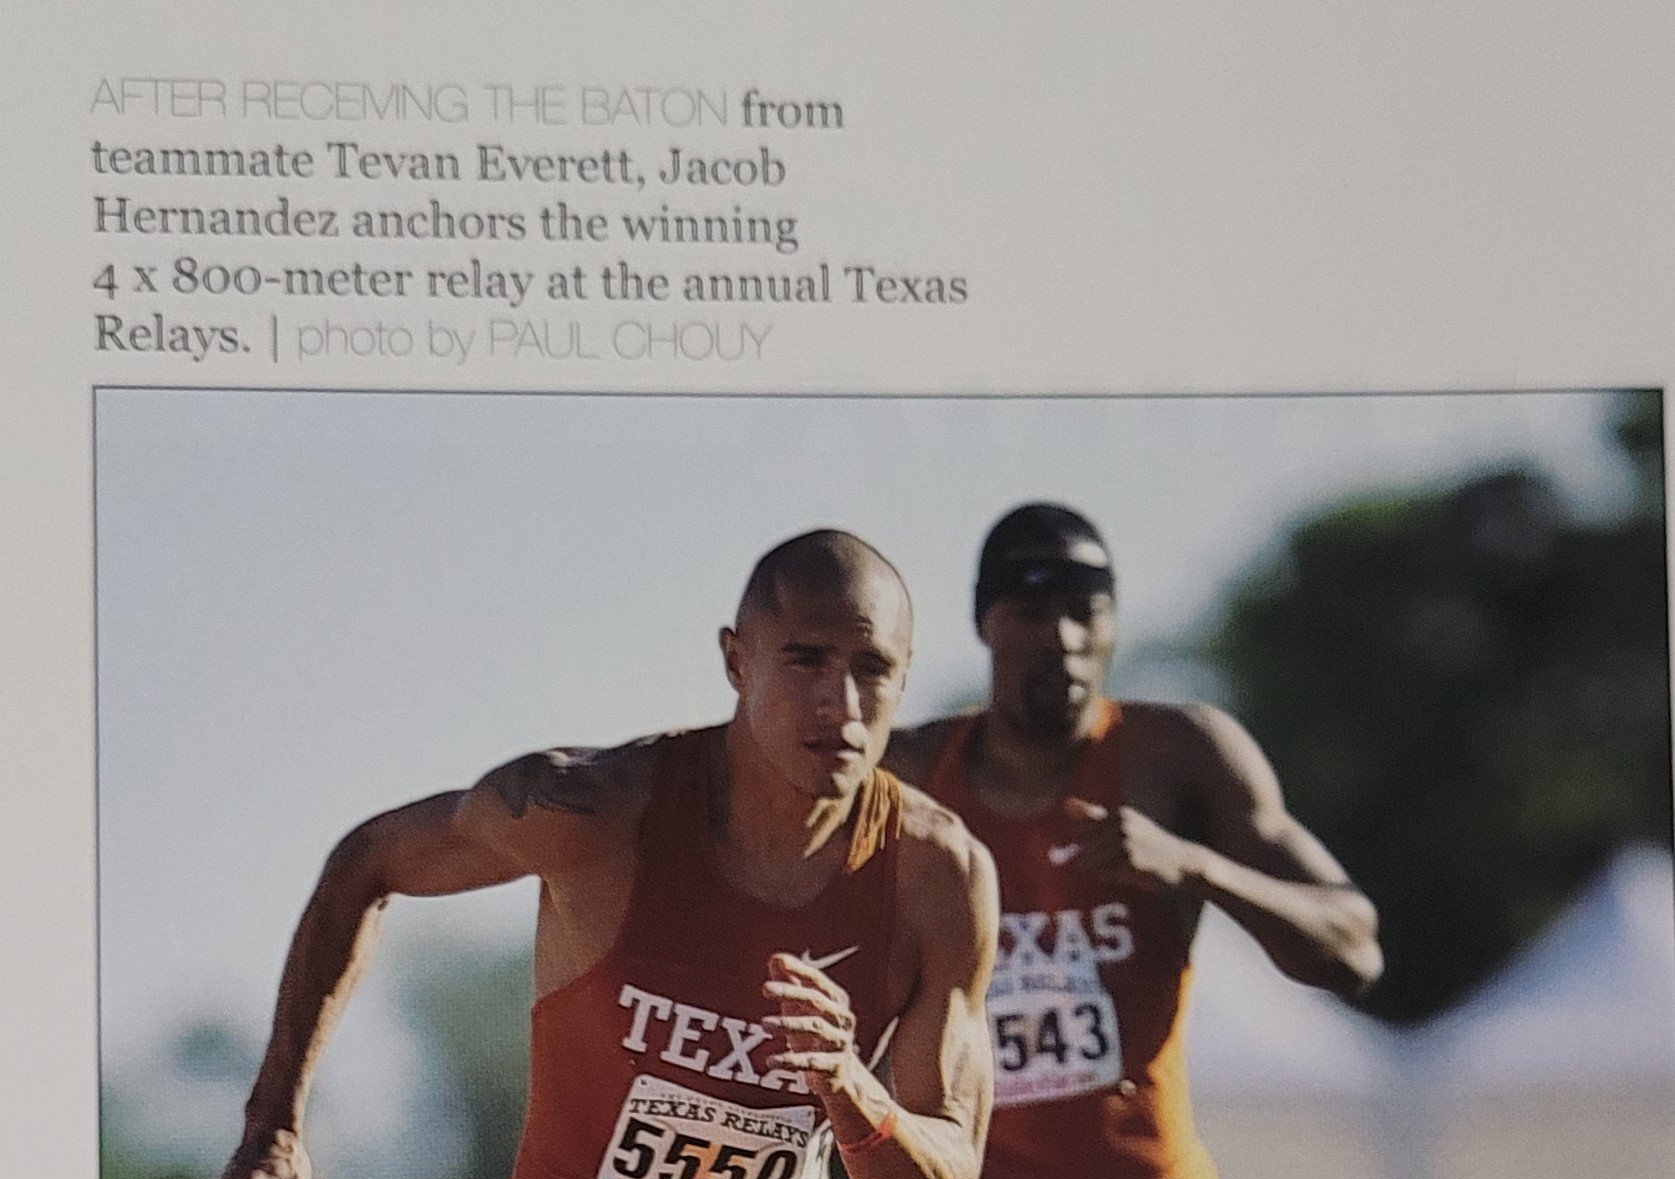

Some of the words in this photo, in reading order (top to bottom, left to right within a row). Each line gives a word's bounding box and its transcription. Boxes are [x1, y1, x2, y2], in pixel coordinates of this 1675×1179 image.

[89, 78, 226, 117] AFTER
[242, 80, 469, 123] RECEIVING
[483, 84, 567, 126] THE
[581, 86, 728, 127] BATON
[741, 87, 845, 129] from
[90, 140, 314, 178] teammate
[326, 141, 461, 181] Tevan
[477, 143, 645, 192] Everett,
[659, 145, 786, 186] Jacob
[93, 195, 339, 237] Hernandez
[352, 198, 527, 240] anchors
[540, 201, 608, 241] the
[621, 204, 799, 254] winning
[92, 263, 119, 300] 4
[133, 264, 158, 293] x
[172, 256, 413, 297] 800-meter
[427, 256, 534, 308] relay
[547, 264, 588, 300] at
[601, 260, 669, 301] the
[683, 262, 830, 303] annual
[843, 264, 969, 305] Texas
[94, 312, 252, 363] Relays.
[298, 318, 413, 359] photo
[427, 320, 476, 365] by
[489, 319, 600, 360] PAUL
[612, 320, 773, 361] CHOUY
[996, 1003, 1110, 1071] 543
[628, 1098, 716, 1124] TEXAS
[720, 1110, 810, 1149] RELAYS
